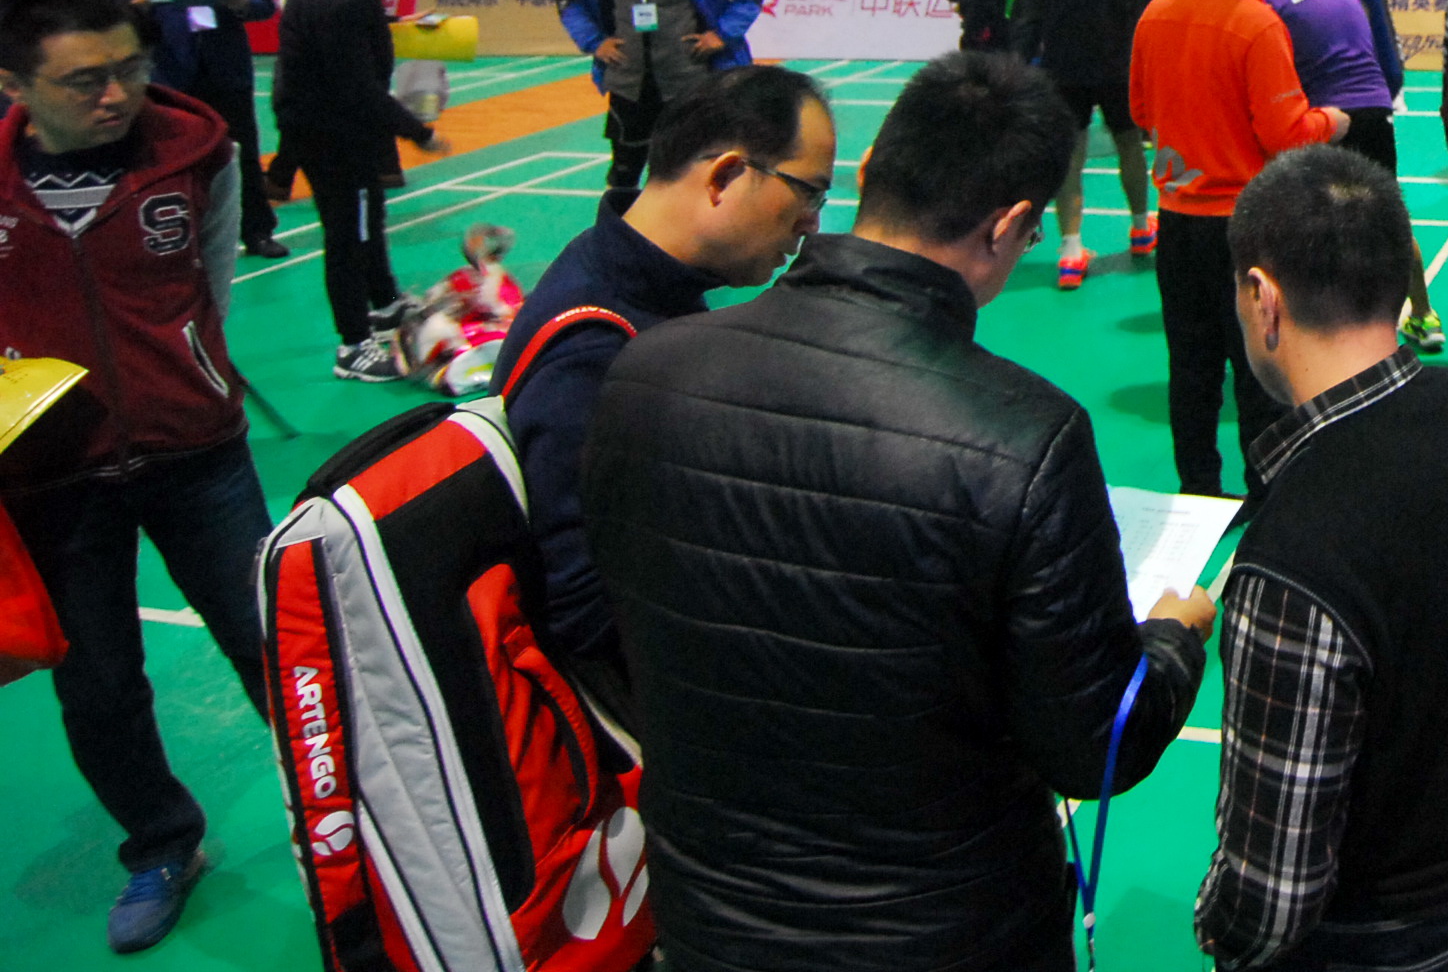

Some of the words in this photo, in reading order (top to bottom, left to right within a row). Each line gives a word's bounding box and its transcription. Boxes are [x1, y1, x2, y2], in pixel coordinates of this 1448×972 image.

[784, 4, 833, 17] PARK
[138, 191, 193, 257] S
[293, 665, 337, 799] ARTENGO
